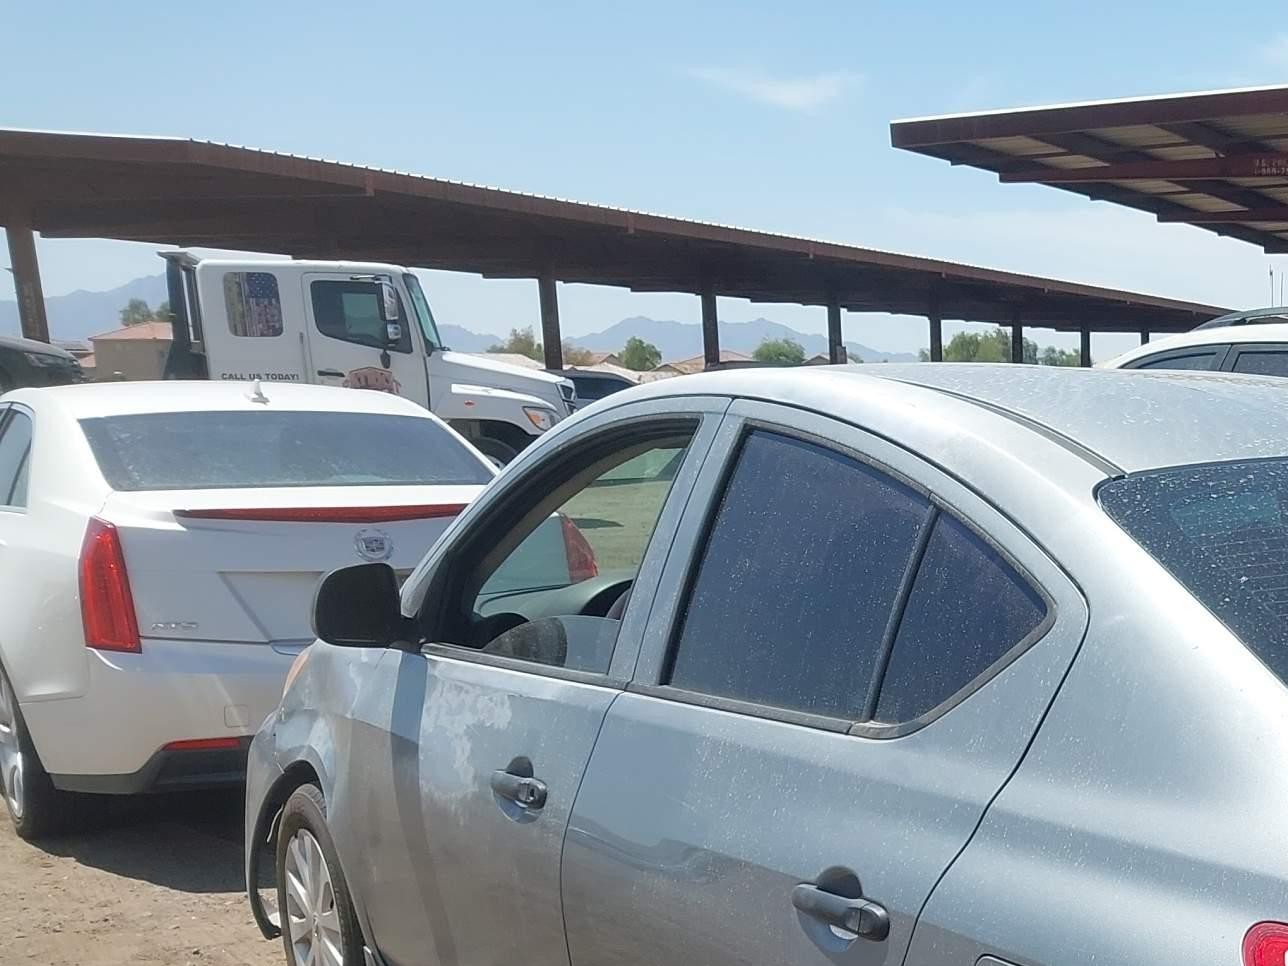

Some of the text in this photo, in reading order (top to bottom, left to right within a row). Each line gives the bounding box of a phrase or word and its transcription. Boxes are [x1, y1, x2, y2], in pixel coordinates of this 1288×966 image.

[221, 372, 300, 381] CALL US TODAY!
